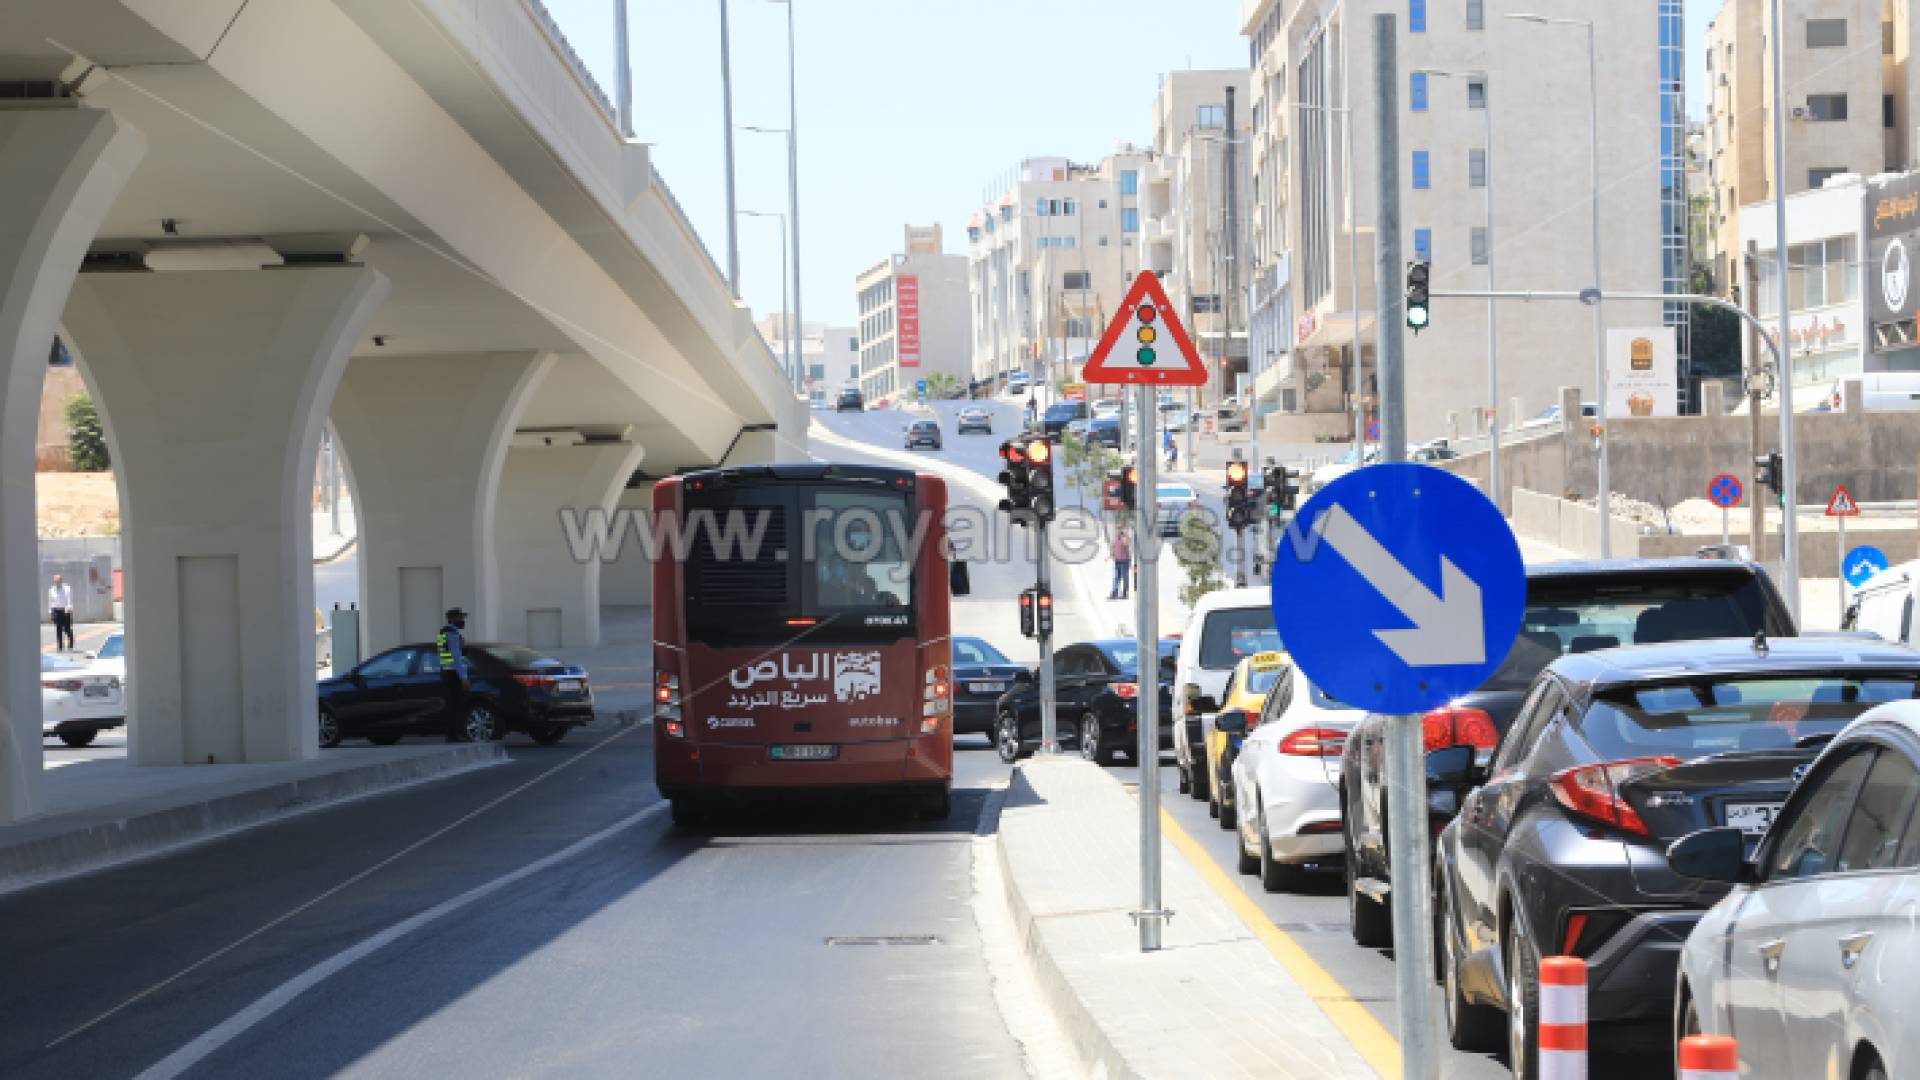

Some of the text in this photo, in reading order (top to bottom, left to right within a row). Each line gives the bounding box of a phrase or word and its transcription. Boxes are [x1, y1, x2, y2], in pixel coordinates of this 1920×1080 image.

[728, 652, 830, 689] الباص
[727, 690, 828, 710] سريع التردد
